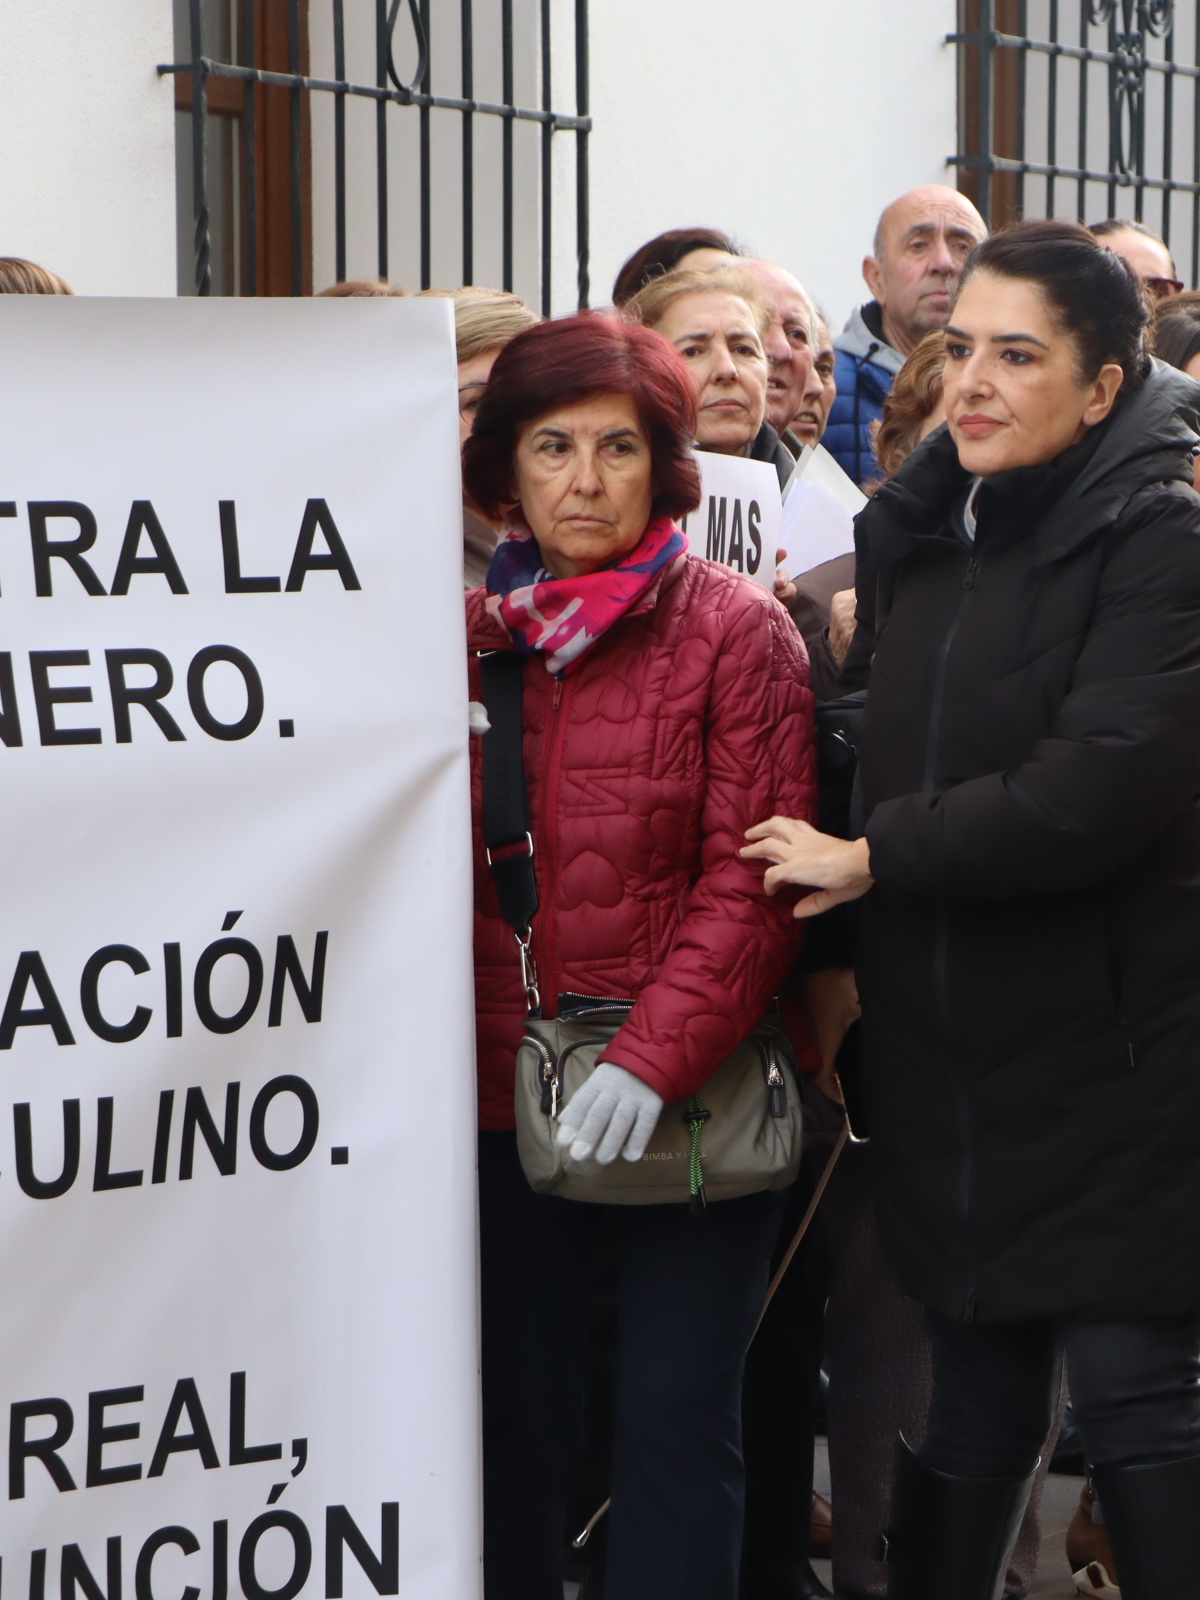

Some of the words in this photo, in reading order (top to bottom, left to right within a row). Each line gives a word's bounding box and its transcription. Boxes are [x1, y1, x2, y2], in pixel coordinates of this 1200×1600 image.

[0, 500, 189, 598] RA
[218, 498, 362, 594] LA
[705, 495, 762, 576] MAS
[0, 910, 329, 1051] ACIÓN
[0, 1074, 349, 1200] ULINO.
[643, 1152, 673, 1161] BIMBA
[684, 1150, 708, 1159] LA
[8, 1370, 308, 1501] REAL,
